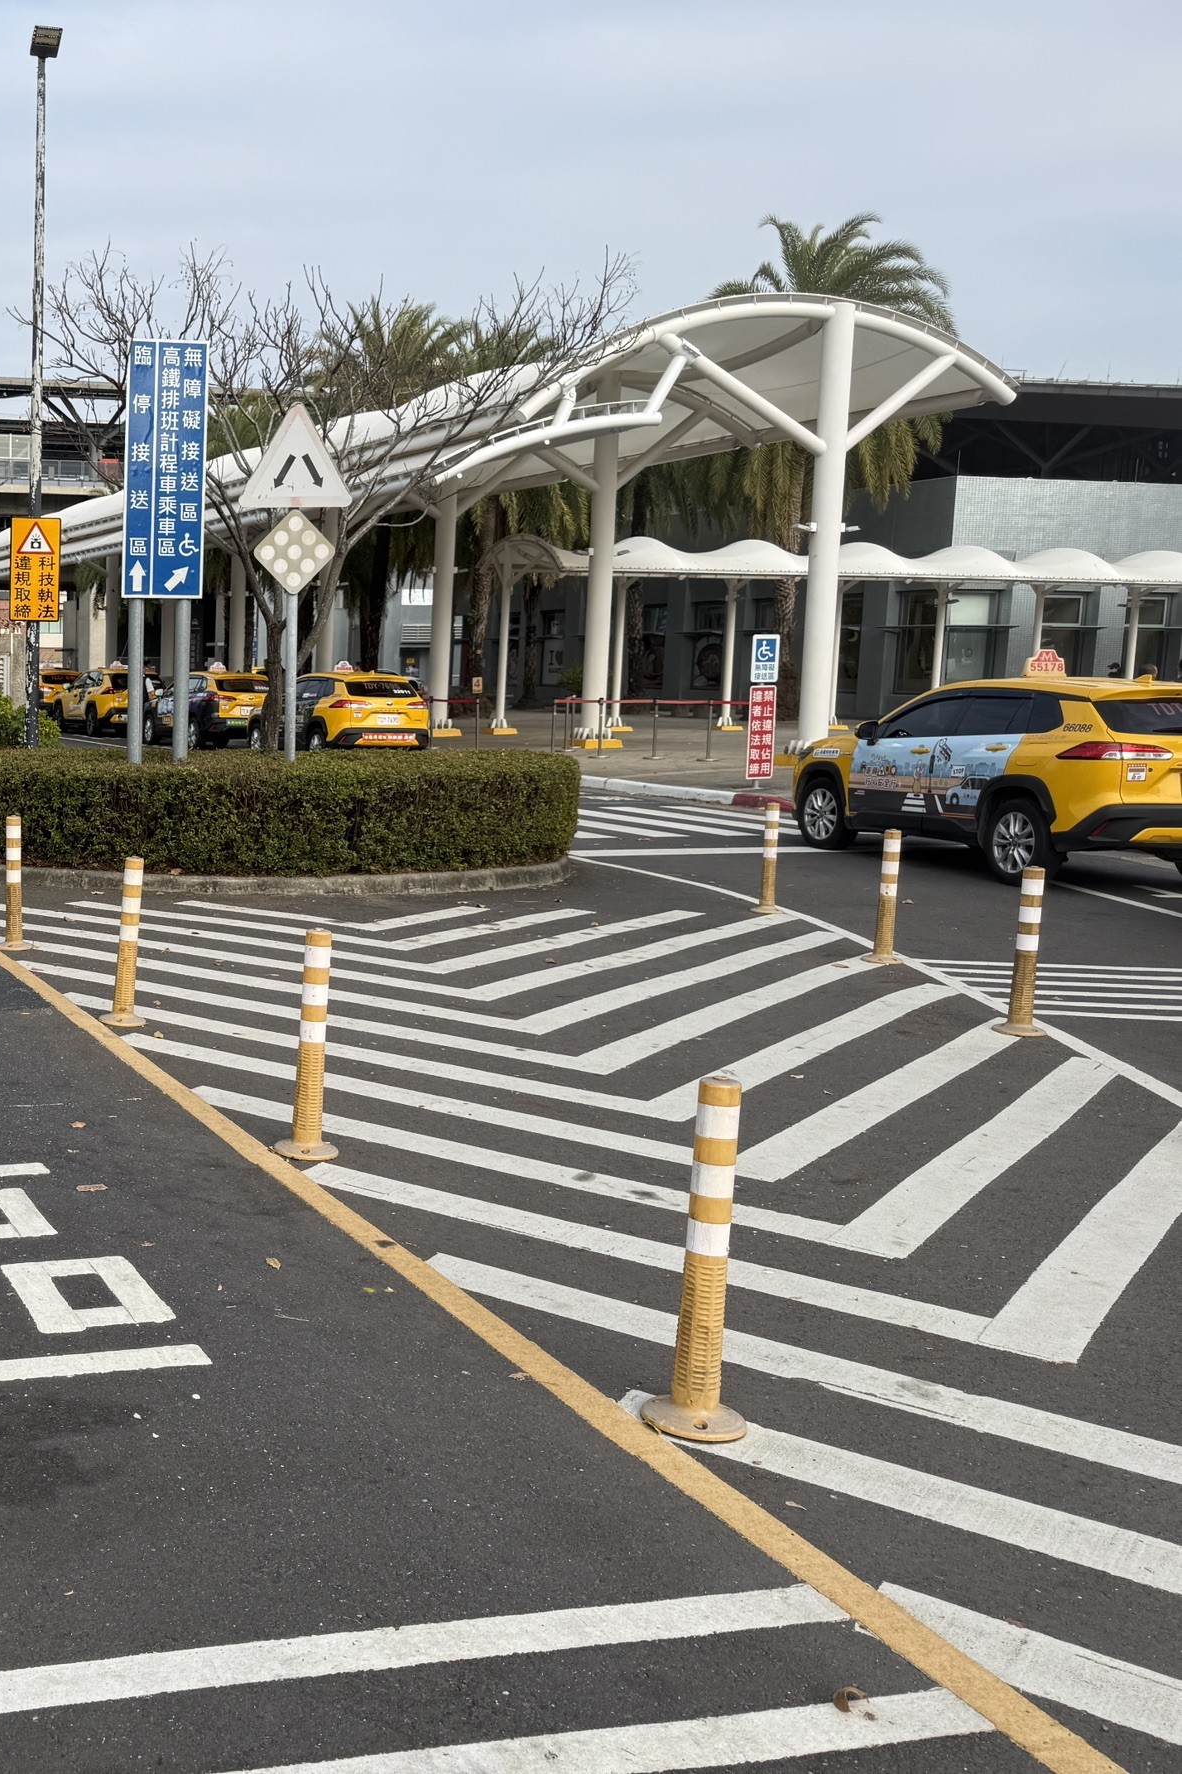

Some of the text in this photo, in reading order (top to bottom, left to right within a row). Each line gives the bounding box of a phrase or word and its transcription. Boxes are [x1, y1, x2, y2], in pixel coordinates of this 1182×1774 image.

[129, 345, 153, 557] 臨停接送區
[158, 347, 181, 557] 高鐵排班計程車乘車區
[180, 347, 203, 522] 無障礙接送區
[14, 555, 32, 618] 違規取締
[37, 556, 56, 619] 科技執法
[473, 678, 481, 689] 4
[754, 664, 775, 672] 無障礙
[754, 672, 775, 680] 接送區
[1030, 662, 1064, 672] 55178
[748, 690, 763, 775] 違者依法取締
[760, 690, 774, 775] 禁止違規佔用
[1063, 723, 1093, 733] 66088
